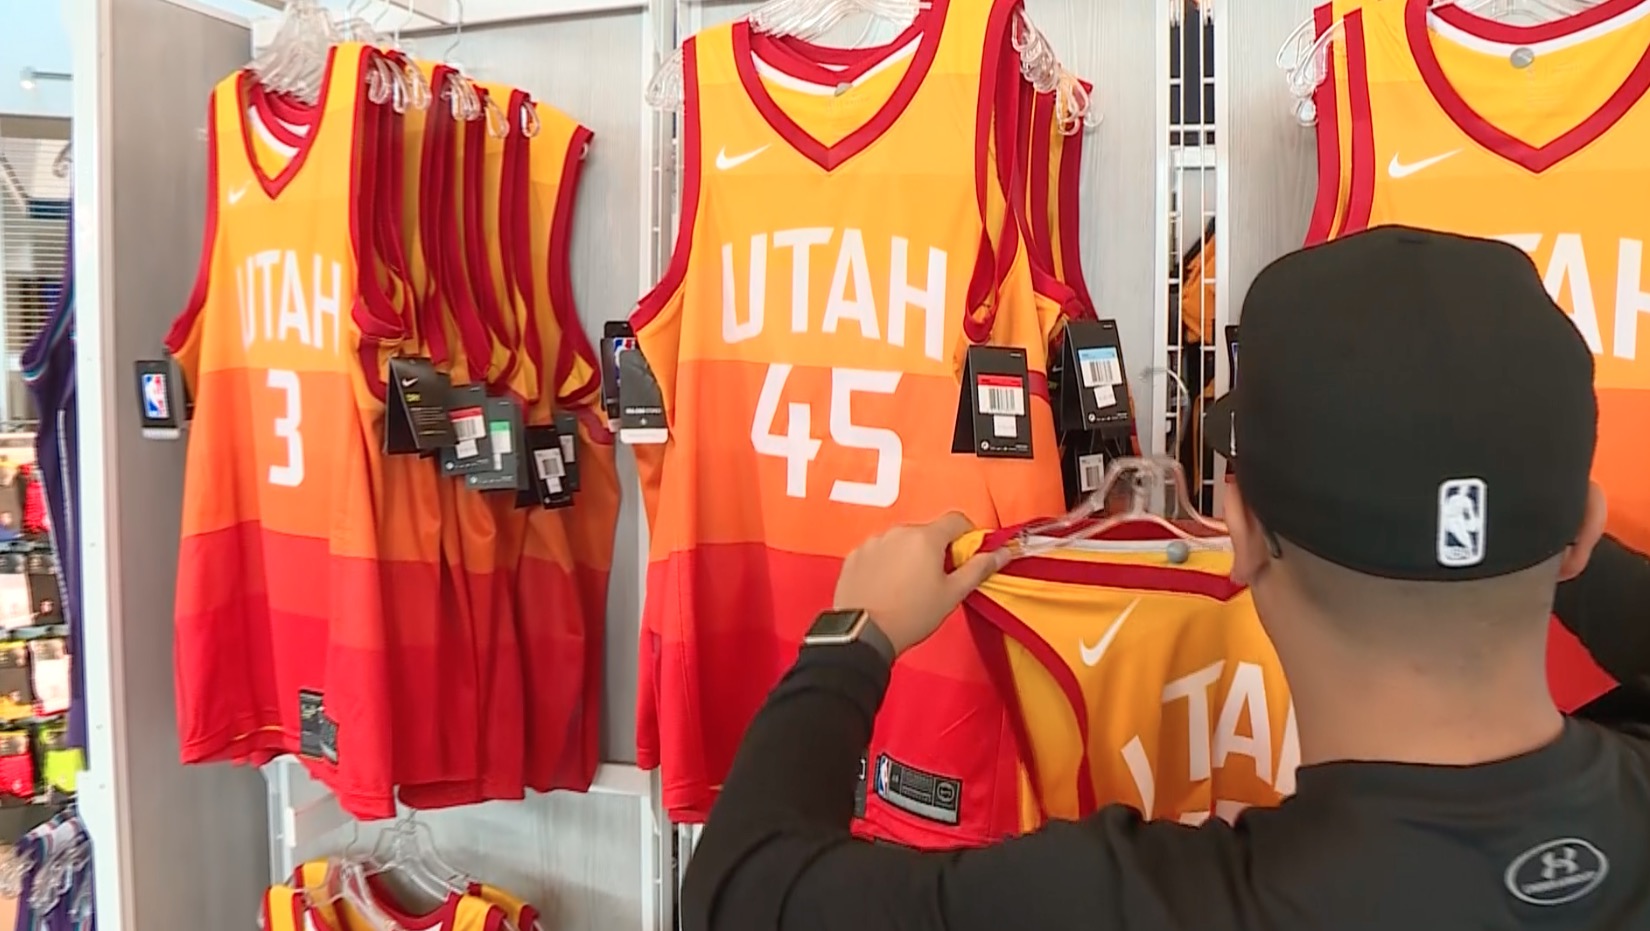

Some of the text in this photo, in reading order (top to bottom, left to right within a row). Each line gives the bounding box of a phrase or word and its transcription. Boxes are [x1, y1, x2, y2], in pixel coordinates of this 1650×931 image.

[235, 249, 341, 357] UTAH
[722, 227, 947, 362] UTAH
[266, 368, 304, 487] 3
[751, 363, 903, 508] 45
